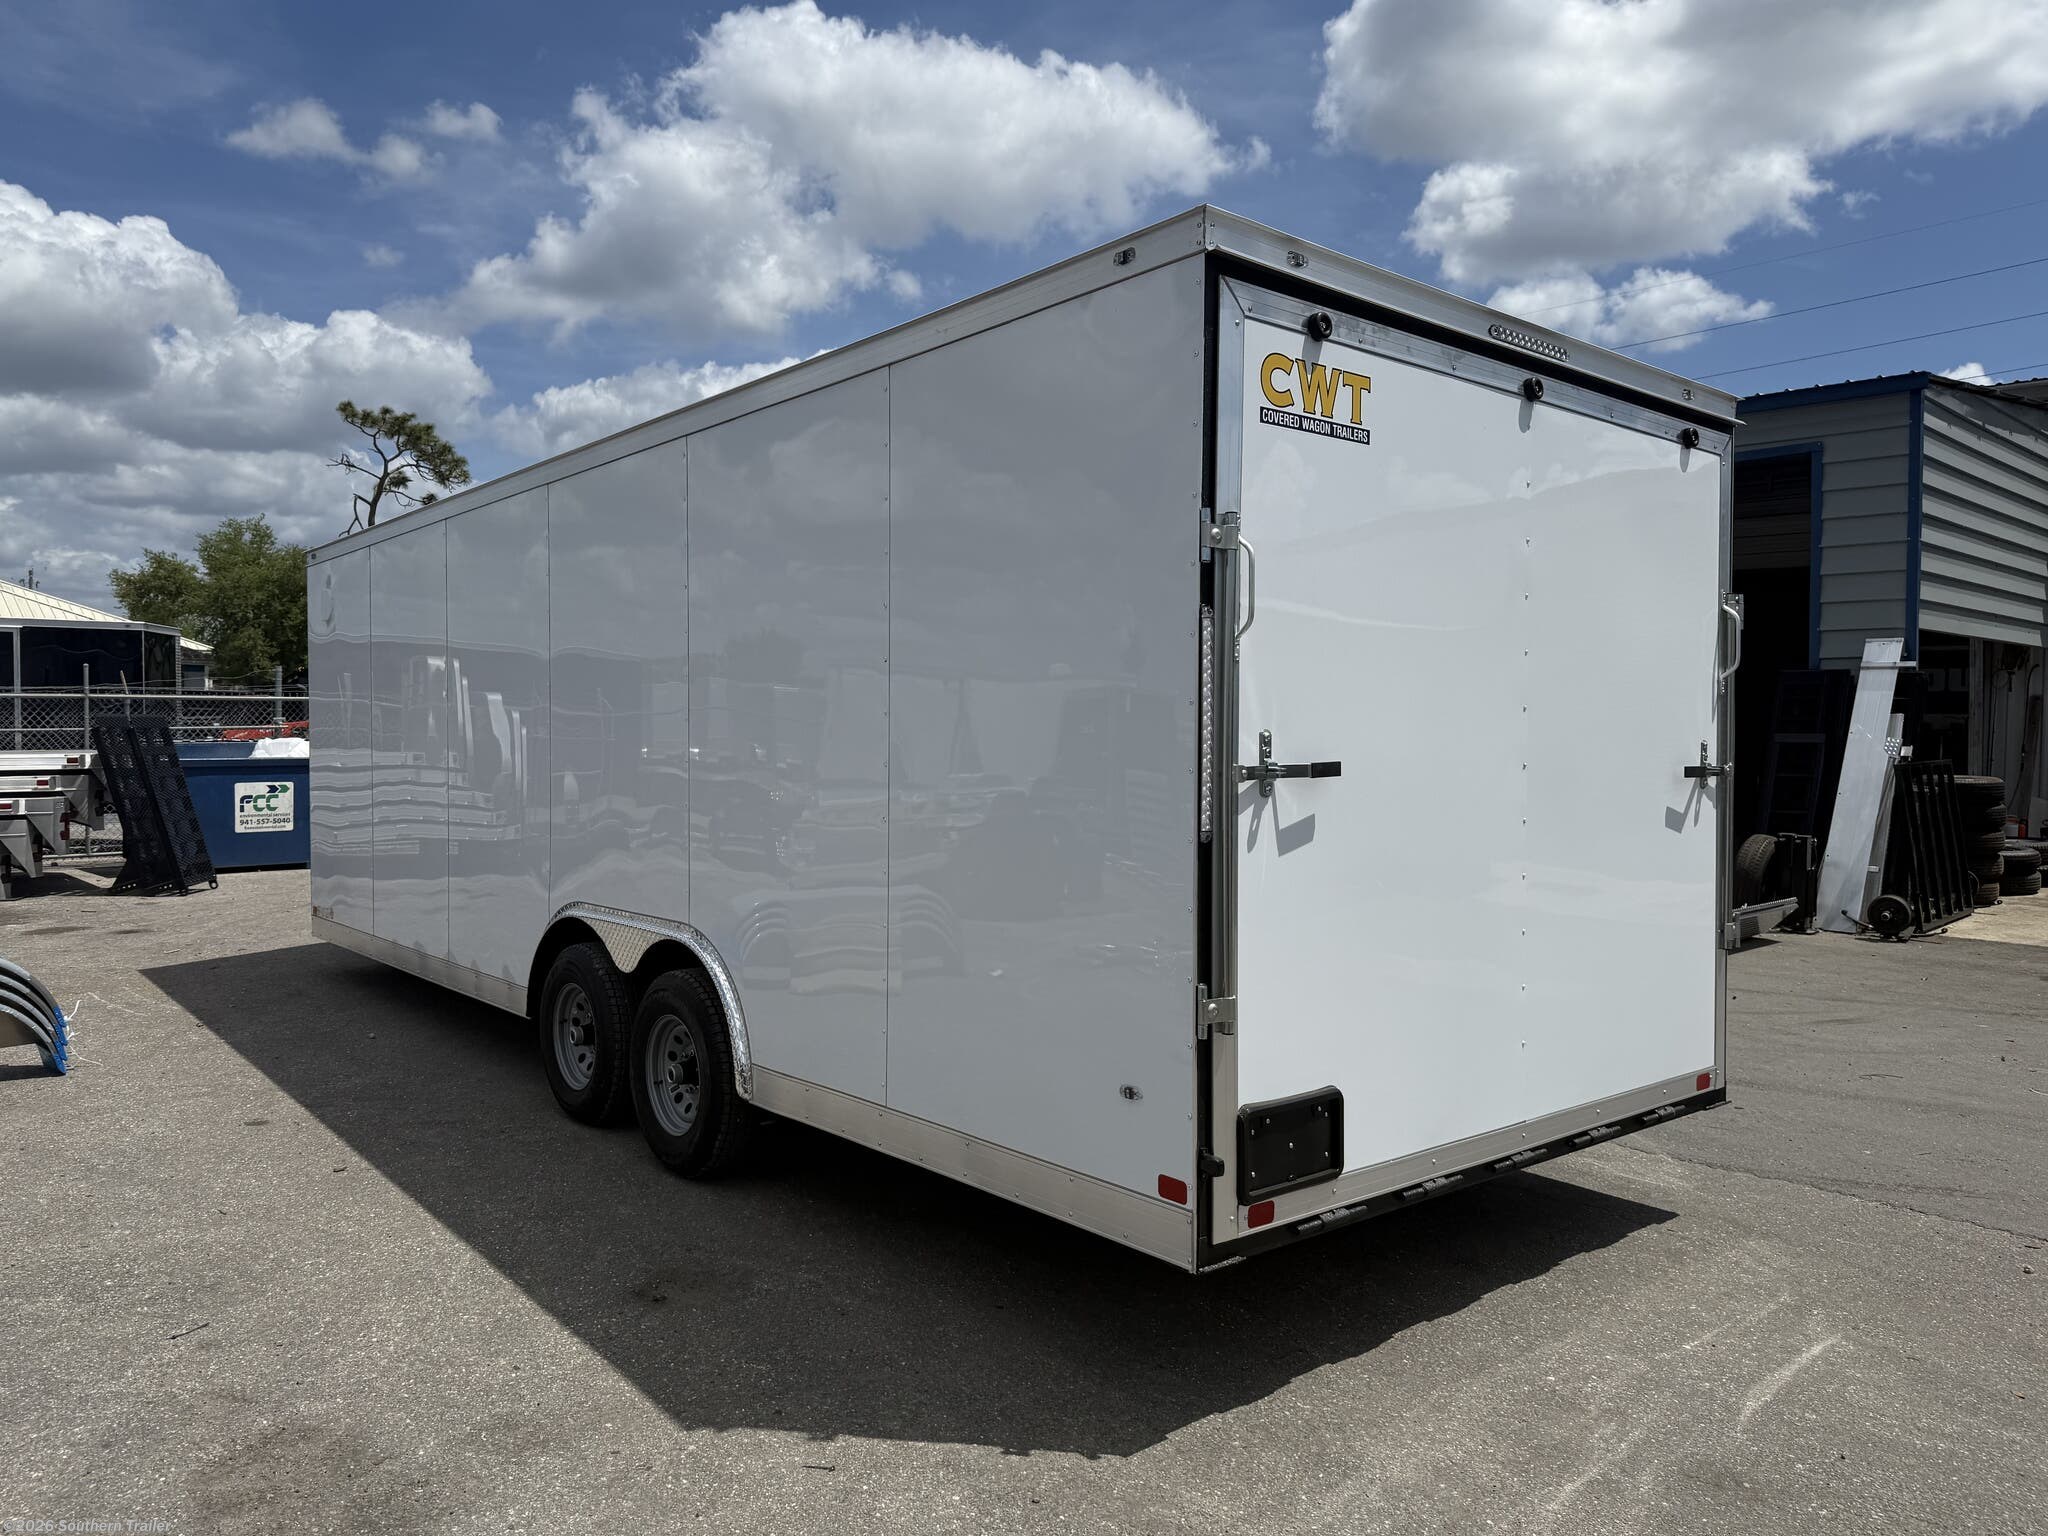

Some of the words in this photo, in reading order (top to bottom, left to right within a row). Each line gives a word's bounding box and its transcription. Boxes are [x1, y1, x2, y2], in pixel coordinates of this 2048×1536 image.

[1261, 352, 1371, 425] CWT
[1262, 408, 1300, 428] COVERED
[1301, 417, 1331, 435] WAGON
[1333, 424, 1368, 443] TRAILERS
[240, 794, 279, 813] FCC
[240, 817, 291, 826] 941-557-5040
